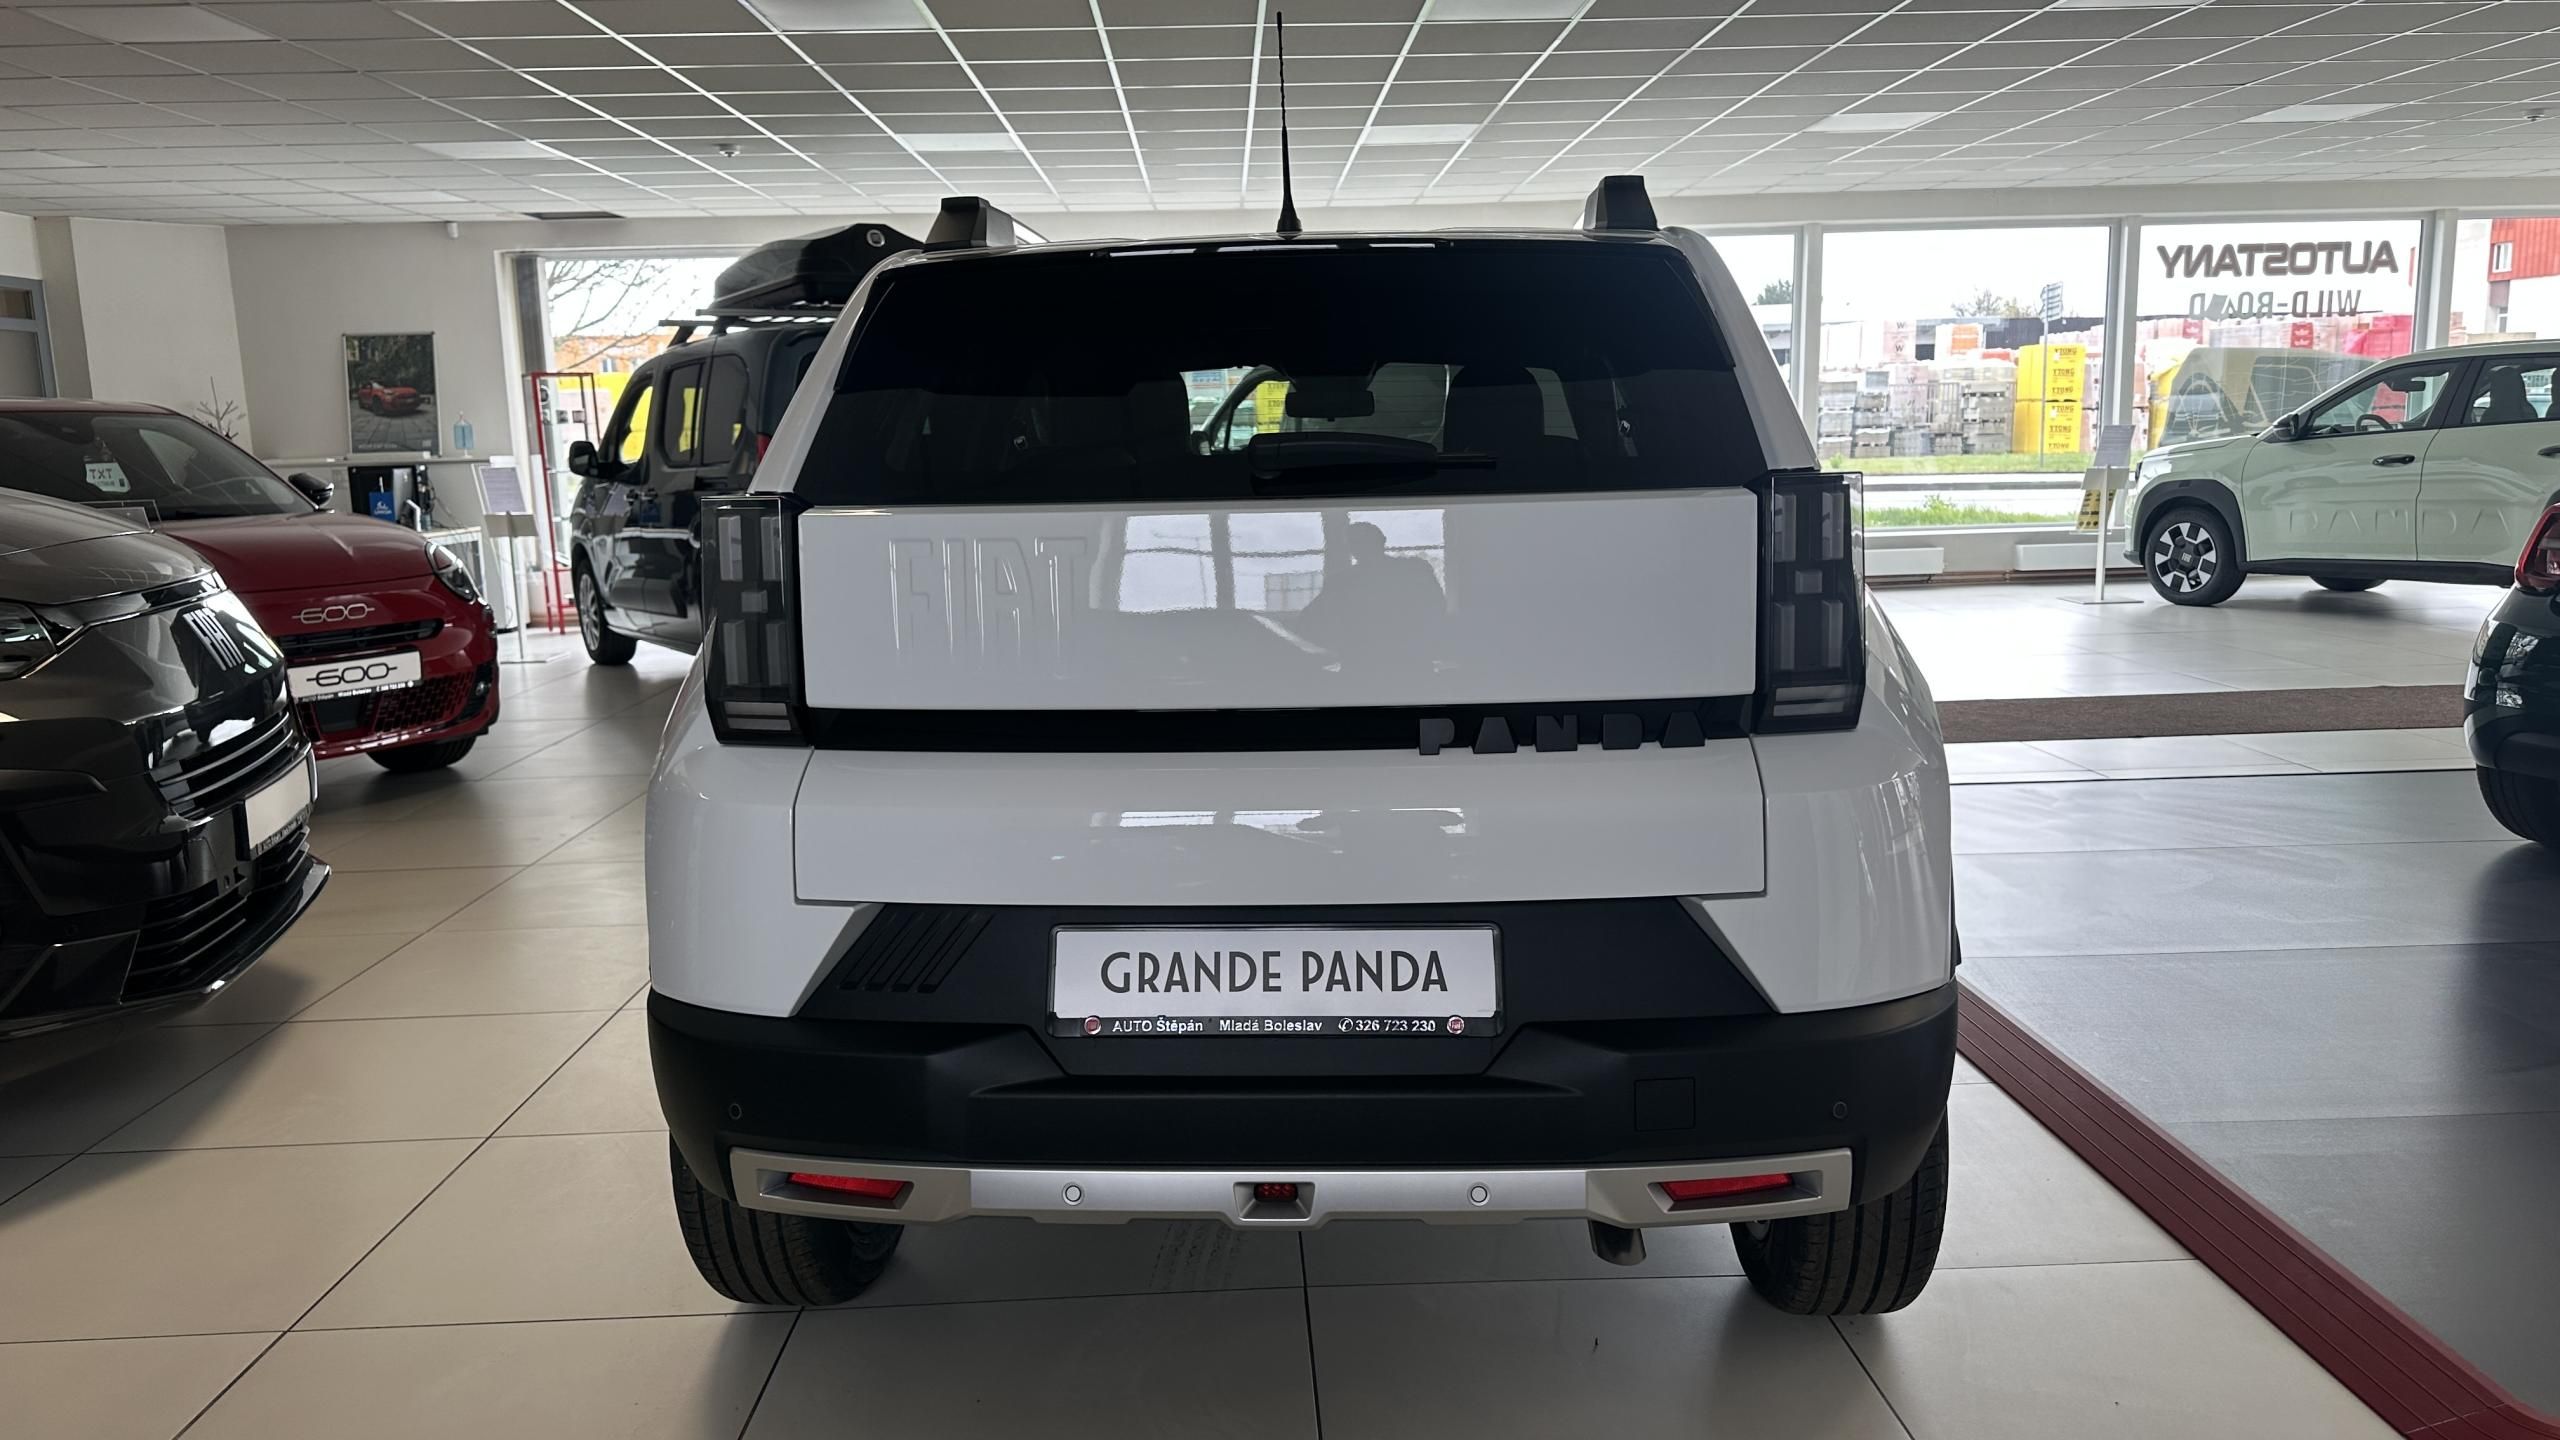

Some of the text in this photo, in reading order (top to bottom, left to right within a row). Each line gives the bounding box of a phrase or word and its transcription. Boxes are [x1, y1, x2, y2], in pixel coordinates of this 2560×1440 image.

[89, 468, 112, 480] TXT
[888, 537, 1088, 660] FIAT
[182, 607, 246, 671] FIAT
[1419, 711, 1706, 756] PANDA
[1100, 950, 1448, 993] GRANDE PANDA
[1112, 1020, 1152, 1032] AUTO
[1156, 1017, 1204, 1035] Štěpán
[1219, 1018, 1260, 1033] Mladá
[1264, 1020, 1323, 1032] Boleslav
[1355, 1020, 1380, 1032] 326
[1384, 1020, 1408, 1032] 723
[1411, 1020, 1436, 1032] 230
